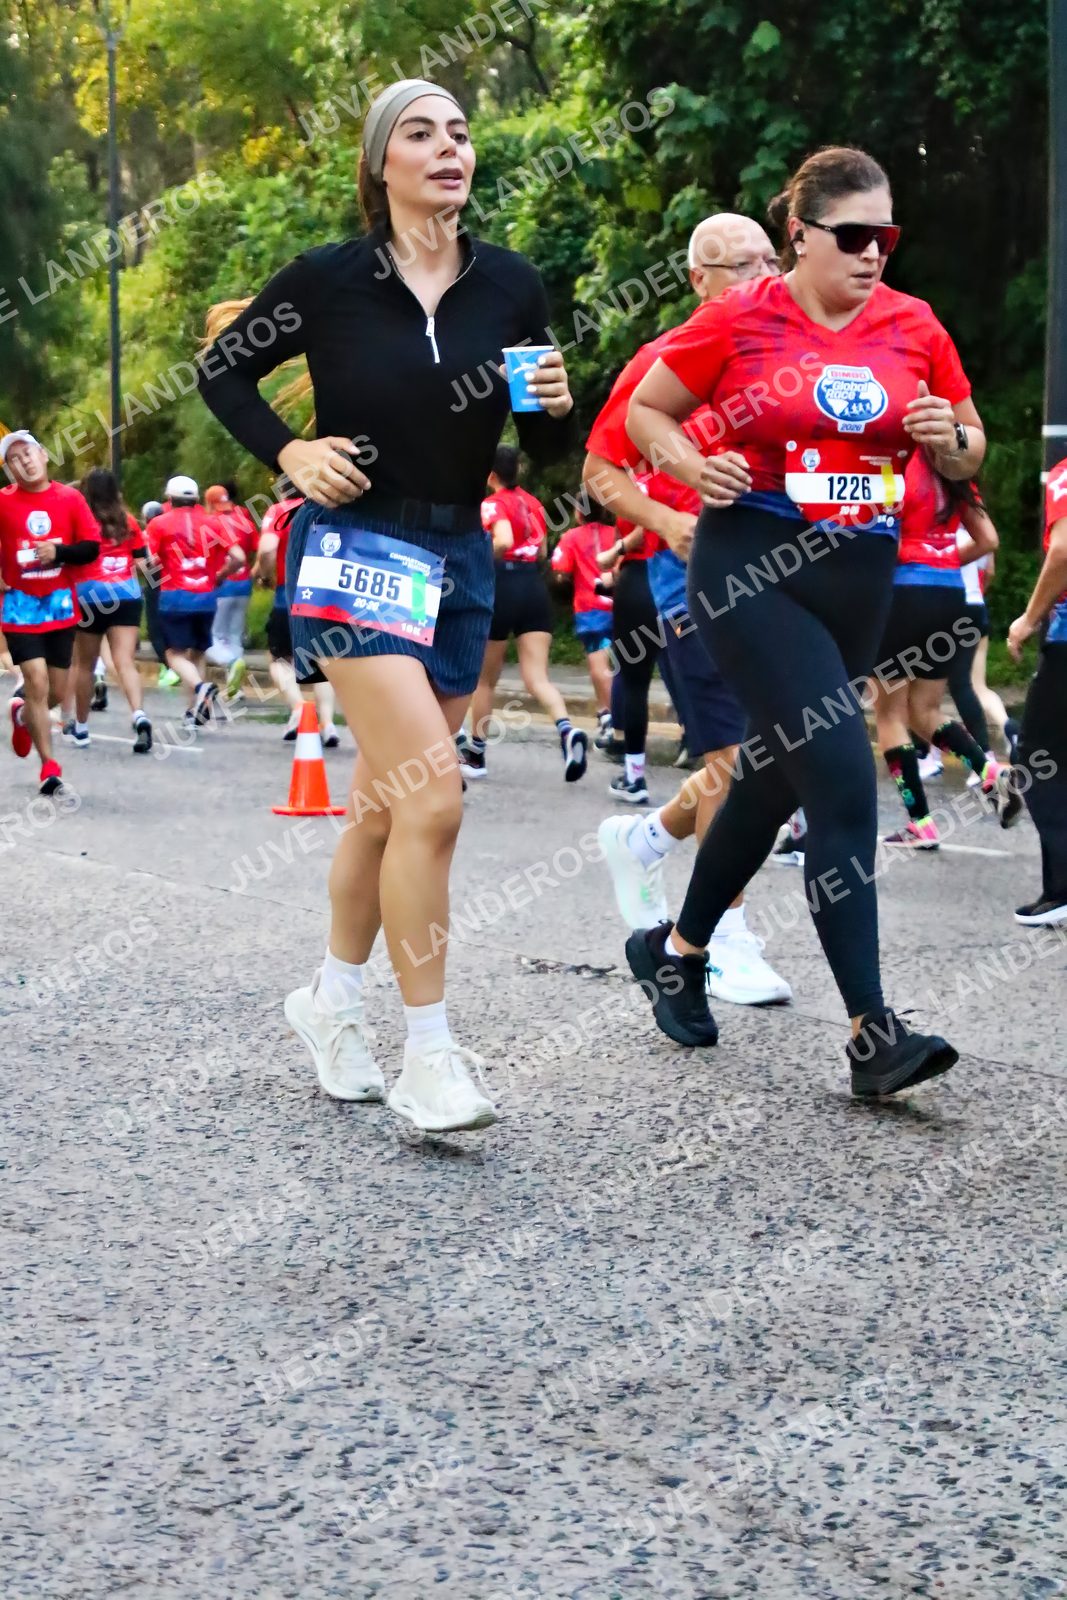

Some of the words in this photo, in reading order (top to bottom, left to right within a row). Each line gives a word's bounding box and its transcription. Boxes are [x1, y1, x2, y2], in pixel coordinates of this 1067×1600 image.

[825, 388, 856, 401] Race
[832, 380, 868, 392] Global
[827, 475, 871, 501] 1226
[338, 563, 401, 601] 5685
